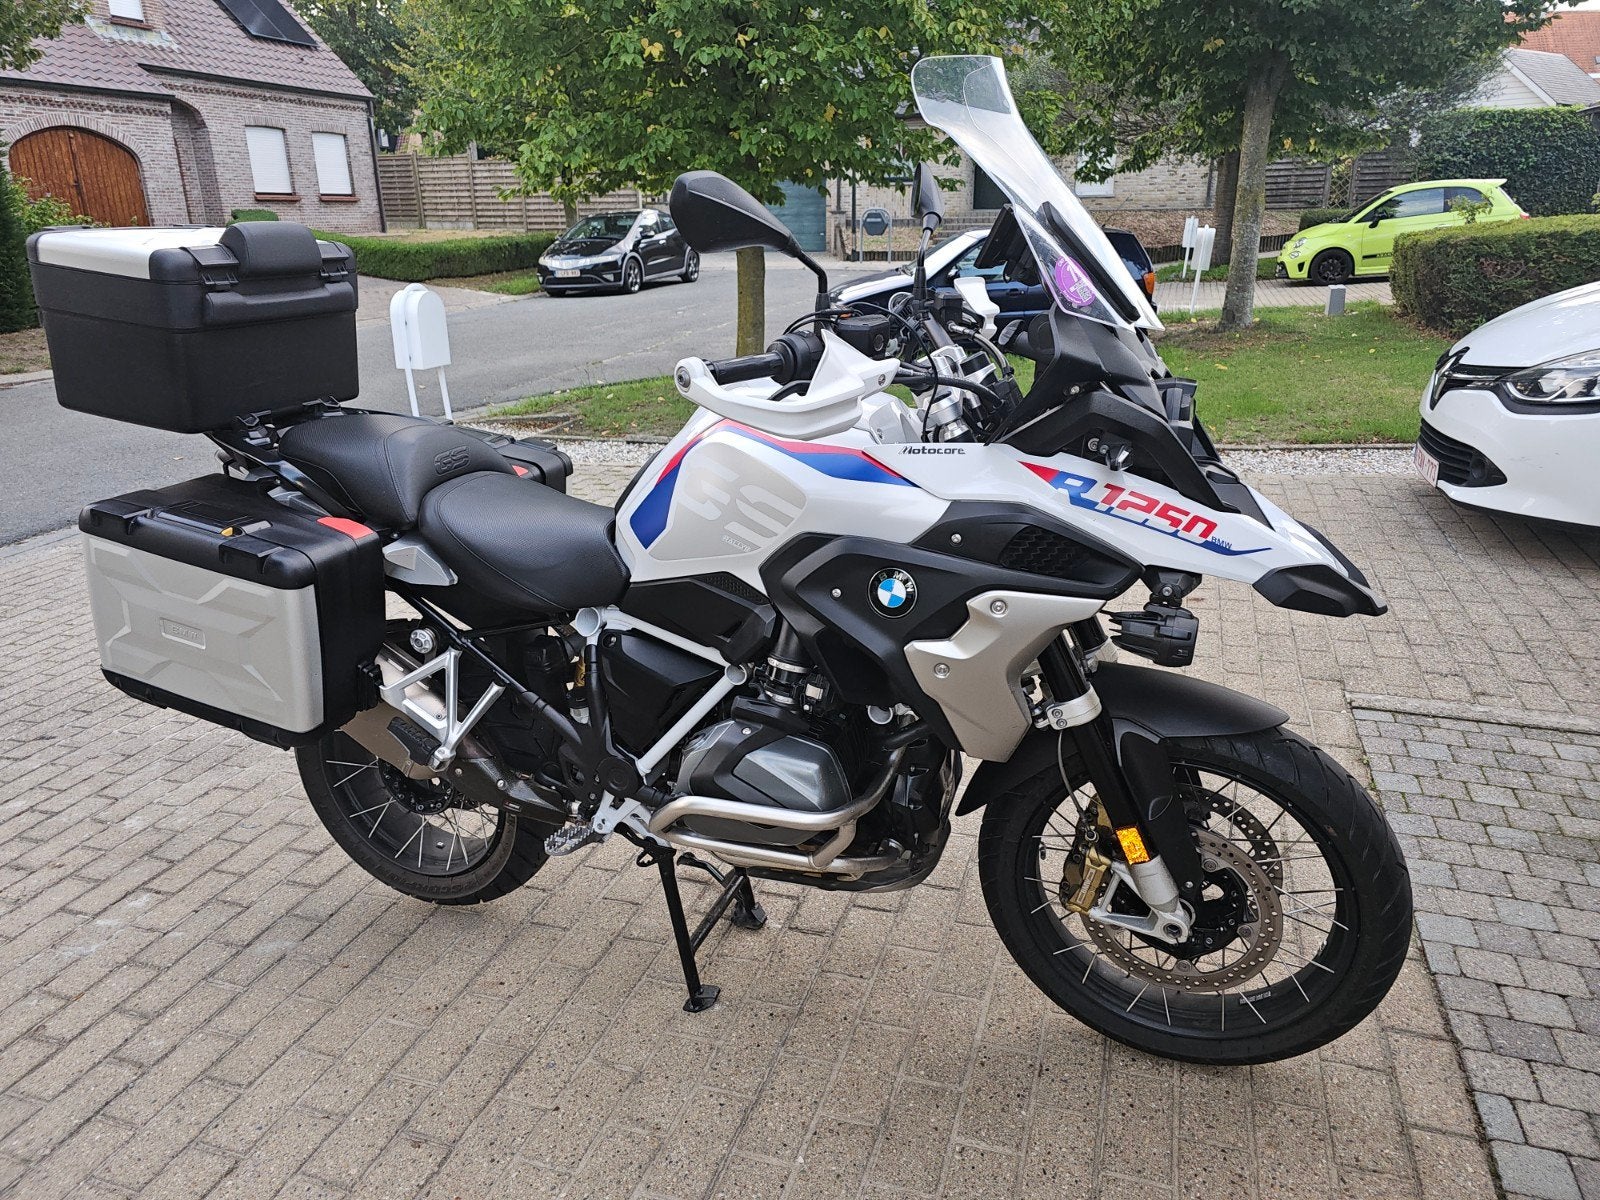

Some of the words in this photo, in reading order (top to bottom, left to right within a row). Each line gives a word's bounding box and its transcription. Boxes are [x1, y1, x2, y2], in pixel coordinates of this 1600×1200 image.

[434, 445, 470, 476] GS
[682, 454, 803, 549] GS
[1100, 482, 1218, 539] 1250
[1211, 535, 1233, 550] BMW
[879, 571, 915, 592] BMW
